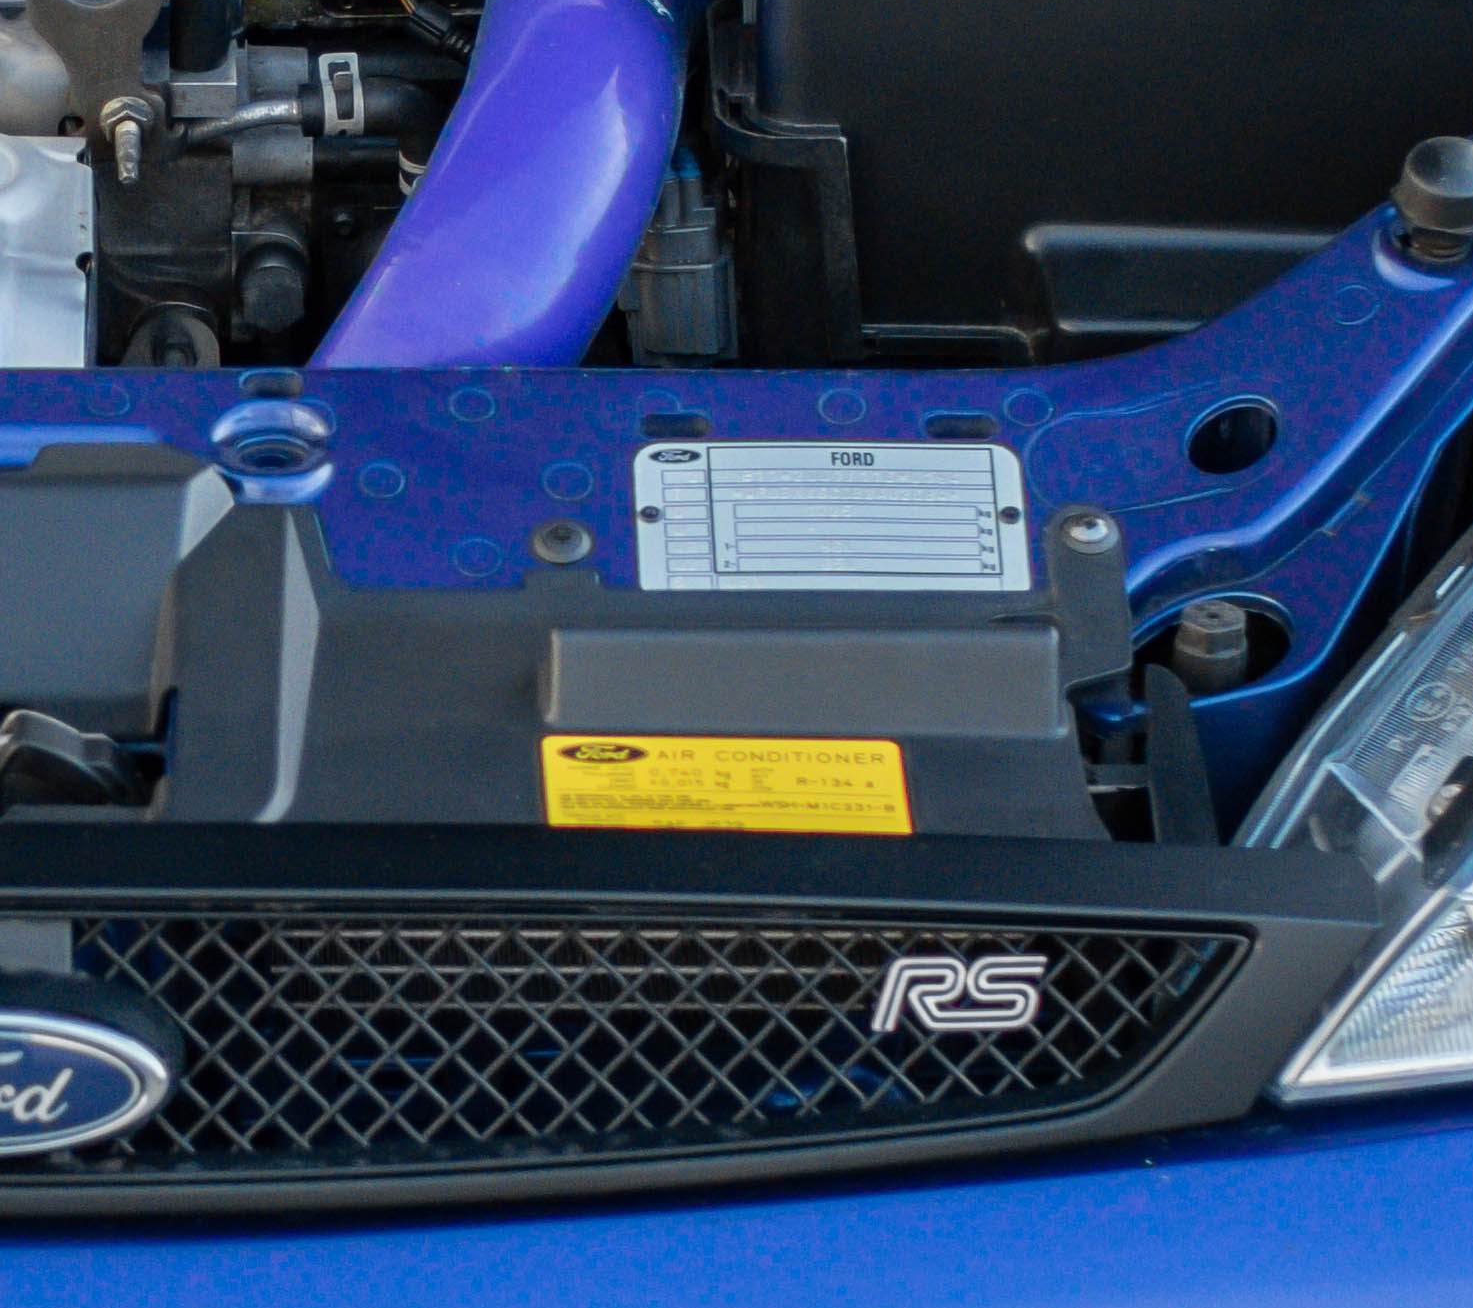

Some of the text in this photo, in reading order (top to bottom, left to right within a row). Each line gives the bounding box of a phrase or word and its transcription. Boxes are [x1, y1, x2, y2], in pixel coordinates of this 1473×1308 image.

[830, 451, 875, 468] FORD
[657, 749, 887, 765] AIR CONDITIONER
[870, 954, 1049, 1033] RS
